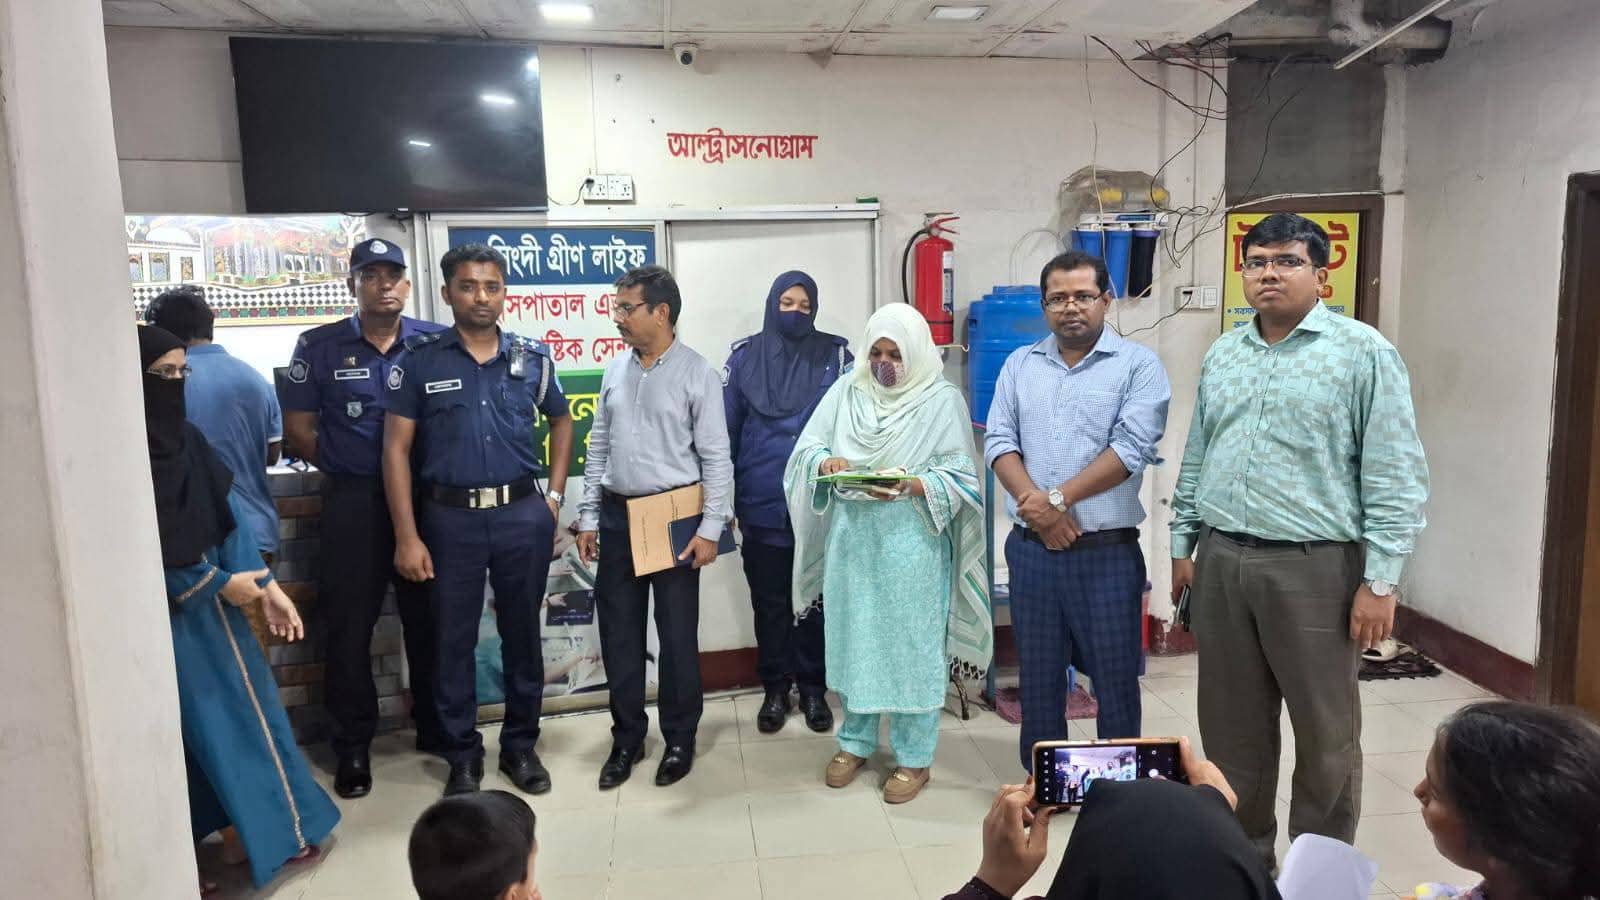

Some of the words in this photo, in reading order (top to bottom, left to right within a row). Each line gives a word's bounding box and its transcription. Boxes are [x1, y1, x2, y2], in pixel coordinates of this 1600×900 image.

[667, 127, 818, 164] আল্ট্রাসনোগ্রাম
[487, 233, 543, 278] সিংদী
[589, 234, 647, 275] লাইফ
[500, 291, 586, 321] সপাতাল
